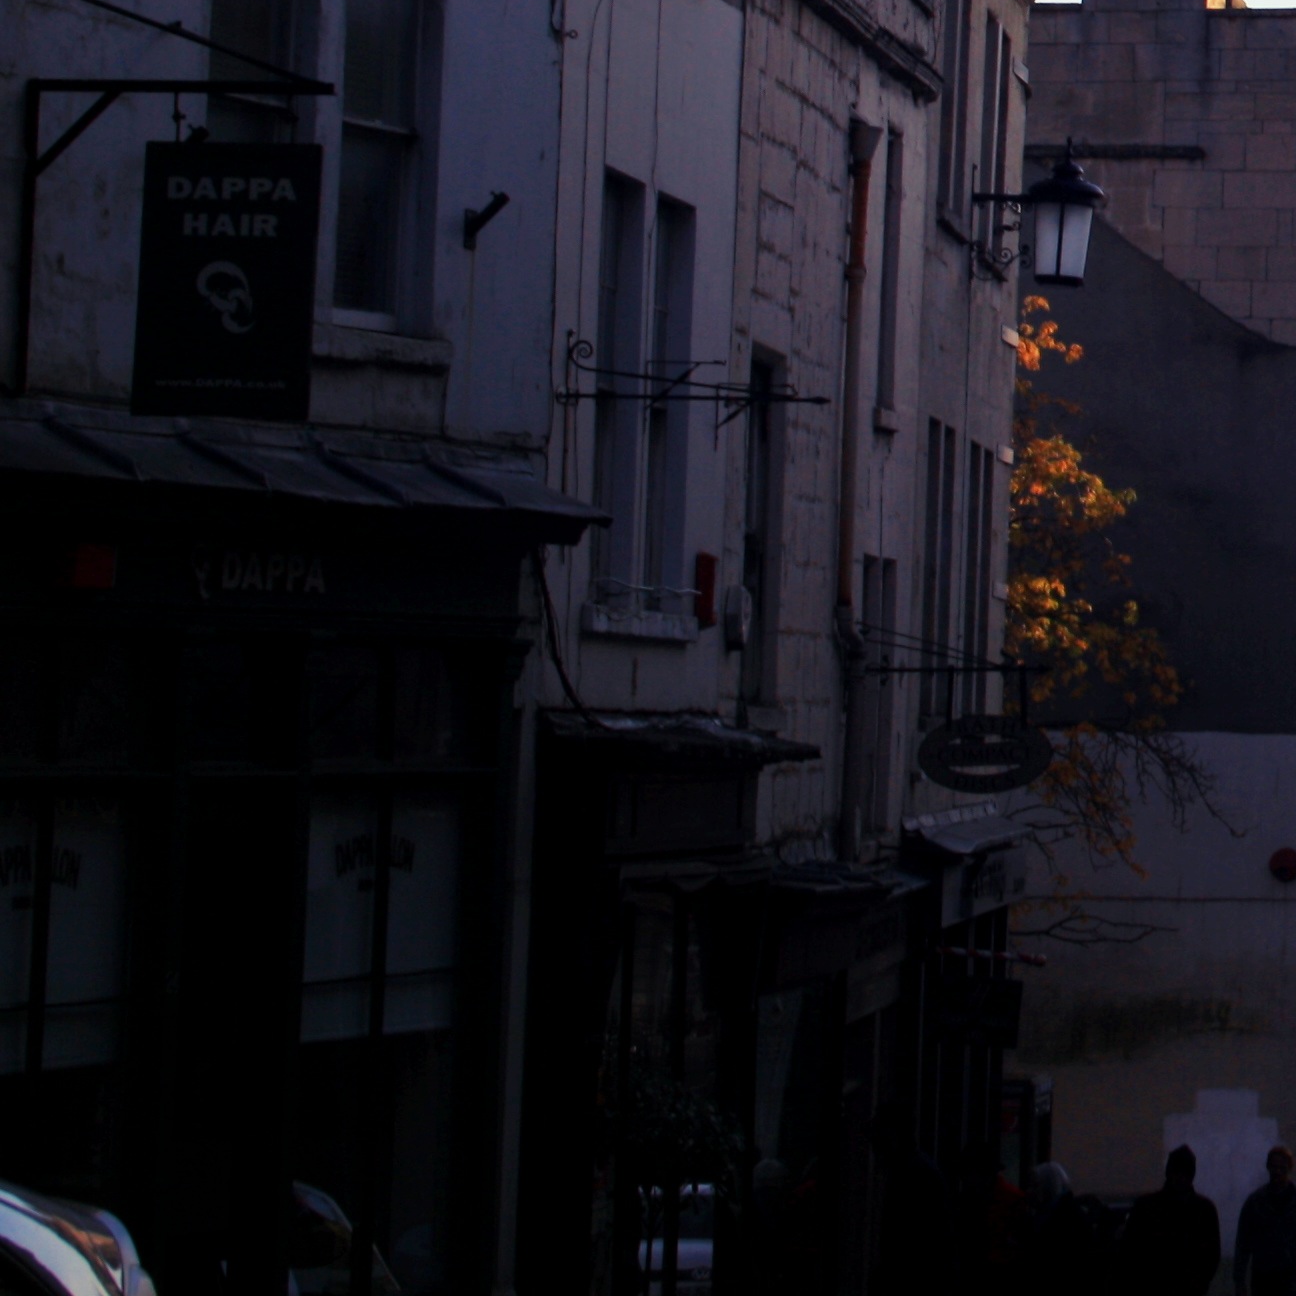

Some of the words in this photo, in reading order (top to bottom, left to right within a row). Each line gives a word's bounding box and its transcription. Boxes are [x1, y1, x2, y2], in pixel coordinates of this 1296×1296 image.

[165, 174, 299, 202] DAPPA
[182, 212, 279, 238] HAIR
[222, 551, 327, 595] DAPPA
[937, 746, 1030, 762] COMPACT
[954, 773, 1016, 790] DISCS
